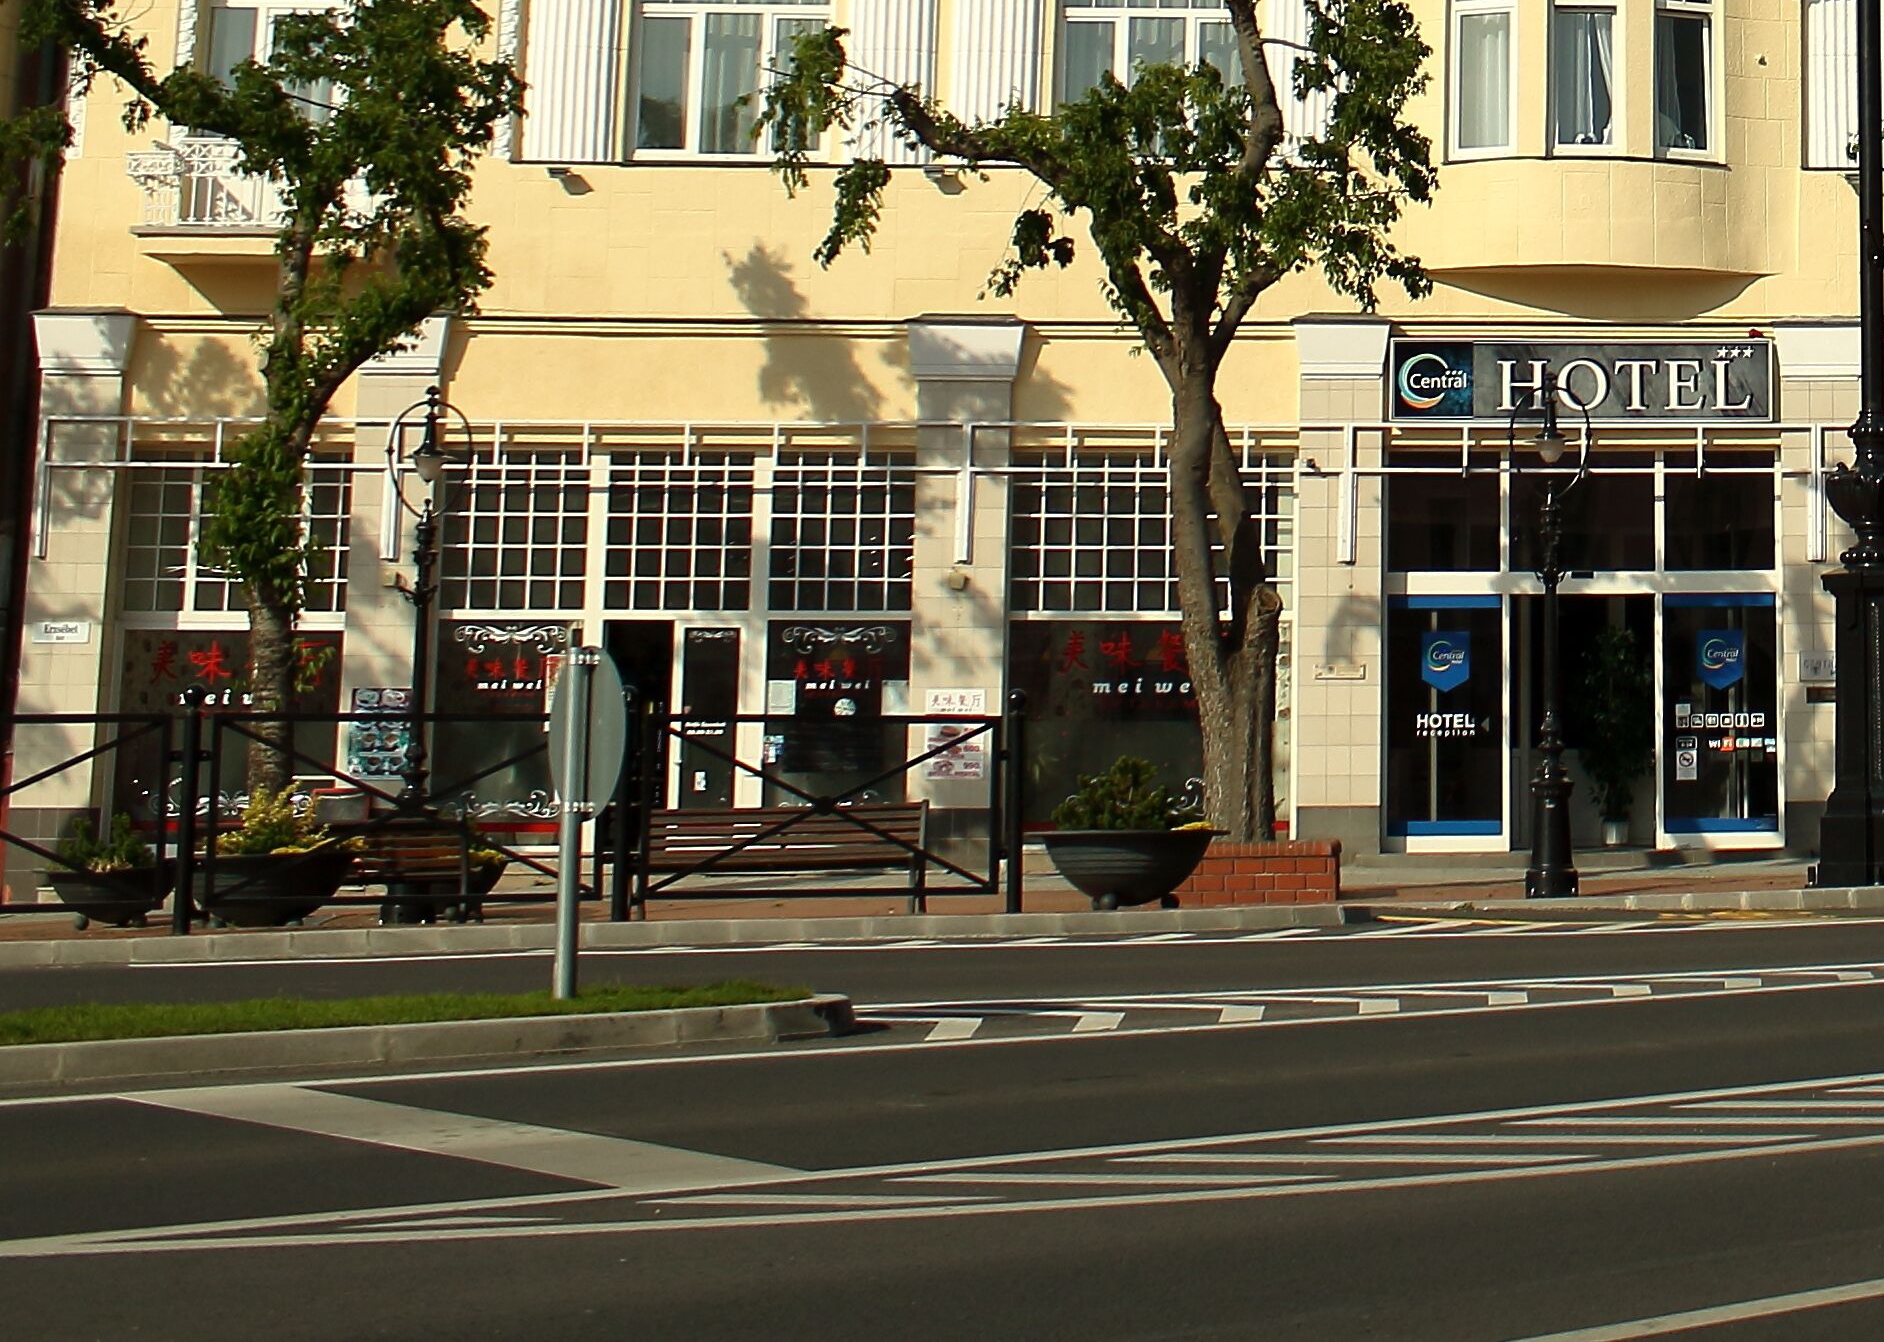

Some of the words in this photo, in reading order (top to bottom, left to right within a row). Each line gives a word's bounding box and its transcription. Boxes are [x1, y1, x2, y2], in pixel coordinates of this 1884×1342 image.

[1409, 371, 1468, 389] Central
[1496, 358, 1753, 411] HOTEL
[1059, 630, 1190, 675] 美味餐
[1707, 648, 1739, 658] Central
[1092, 677, 1144, 694] mei
[1154, 683, 1191, 694] we
[1416, 713, 1476, 729] HOTEL
[1416, 729, 1476, 738] reception
